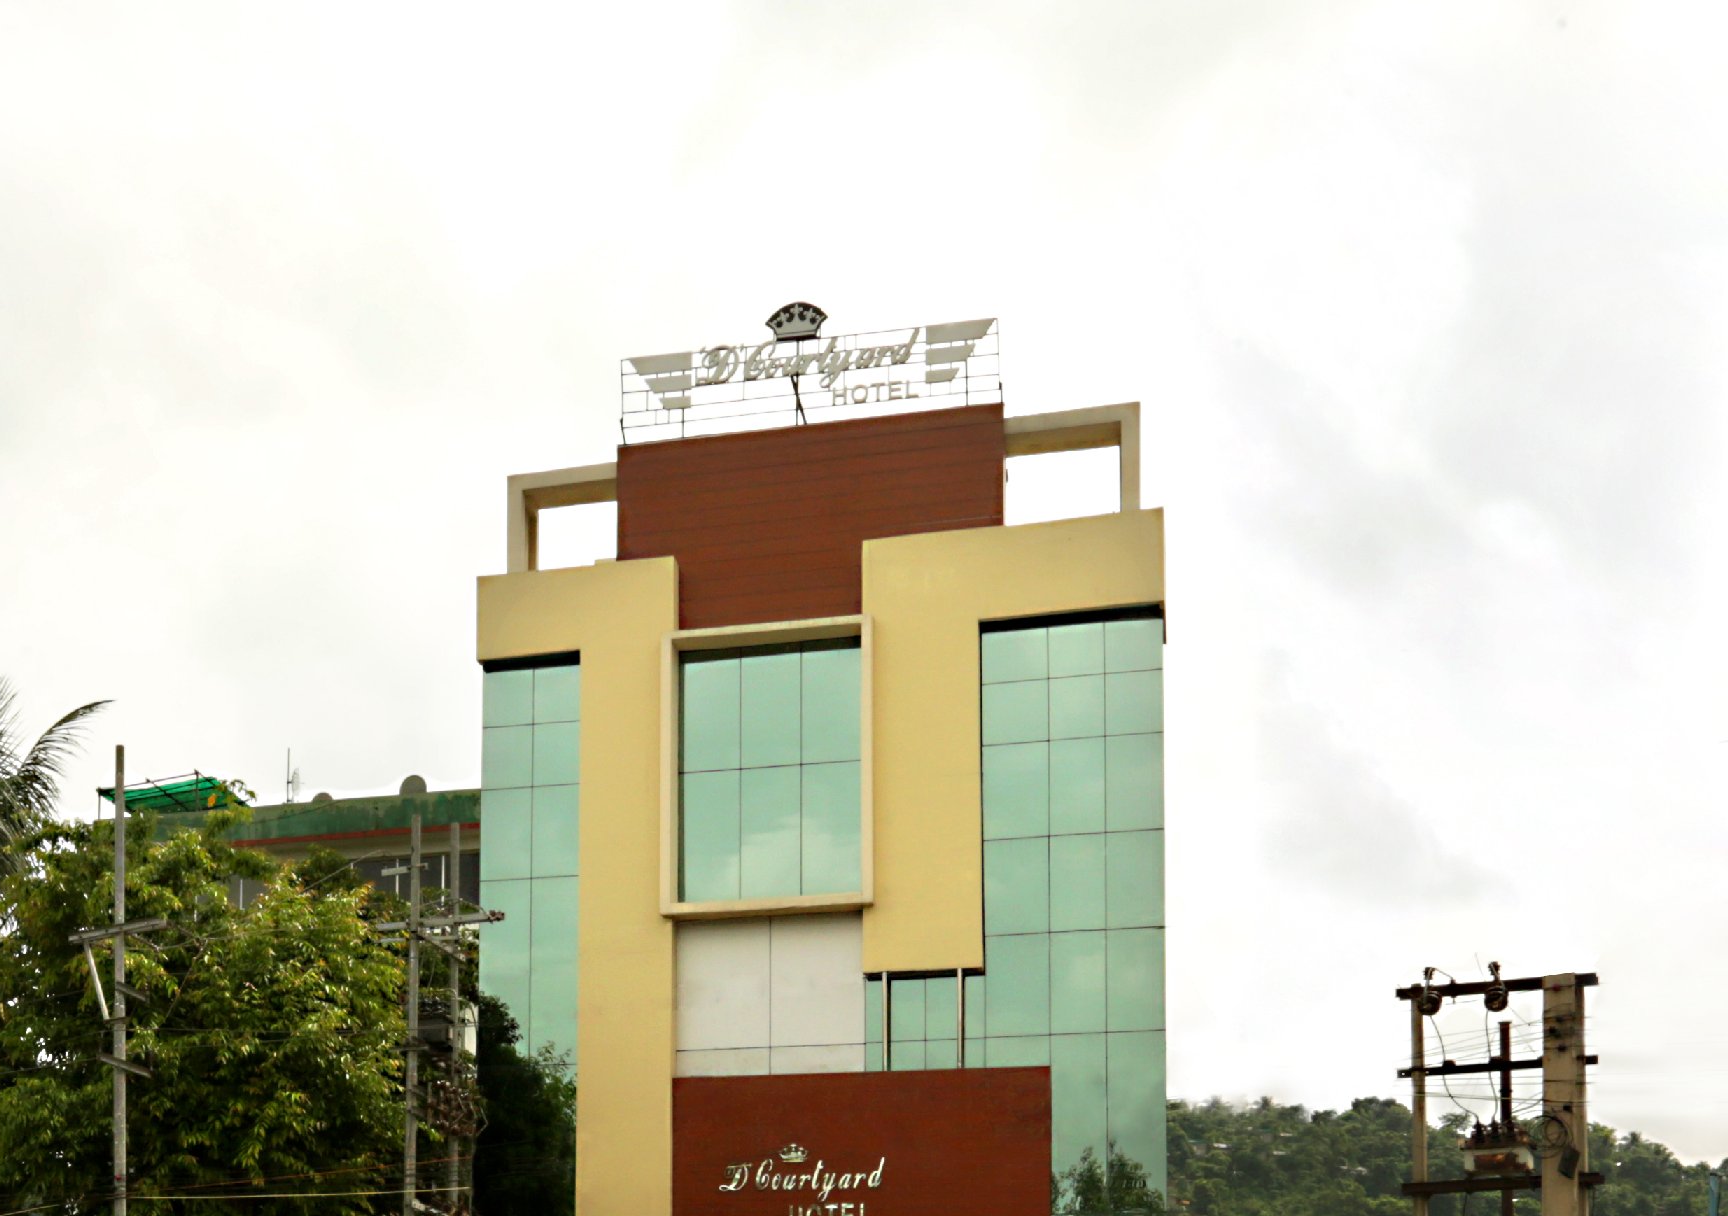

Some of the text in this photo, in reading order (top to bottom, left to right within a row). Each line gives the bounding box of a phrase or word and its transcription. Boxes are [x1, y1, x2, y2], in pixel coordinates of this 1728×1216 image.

[744, 328, 920, 388] Courtyard
[833, 380, 919, 406] HOTEL
[756, 1157, 885, 1201] Courtyard
